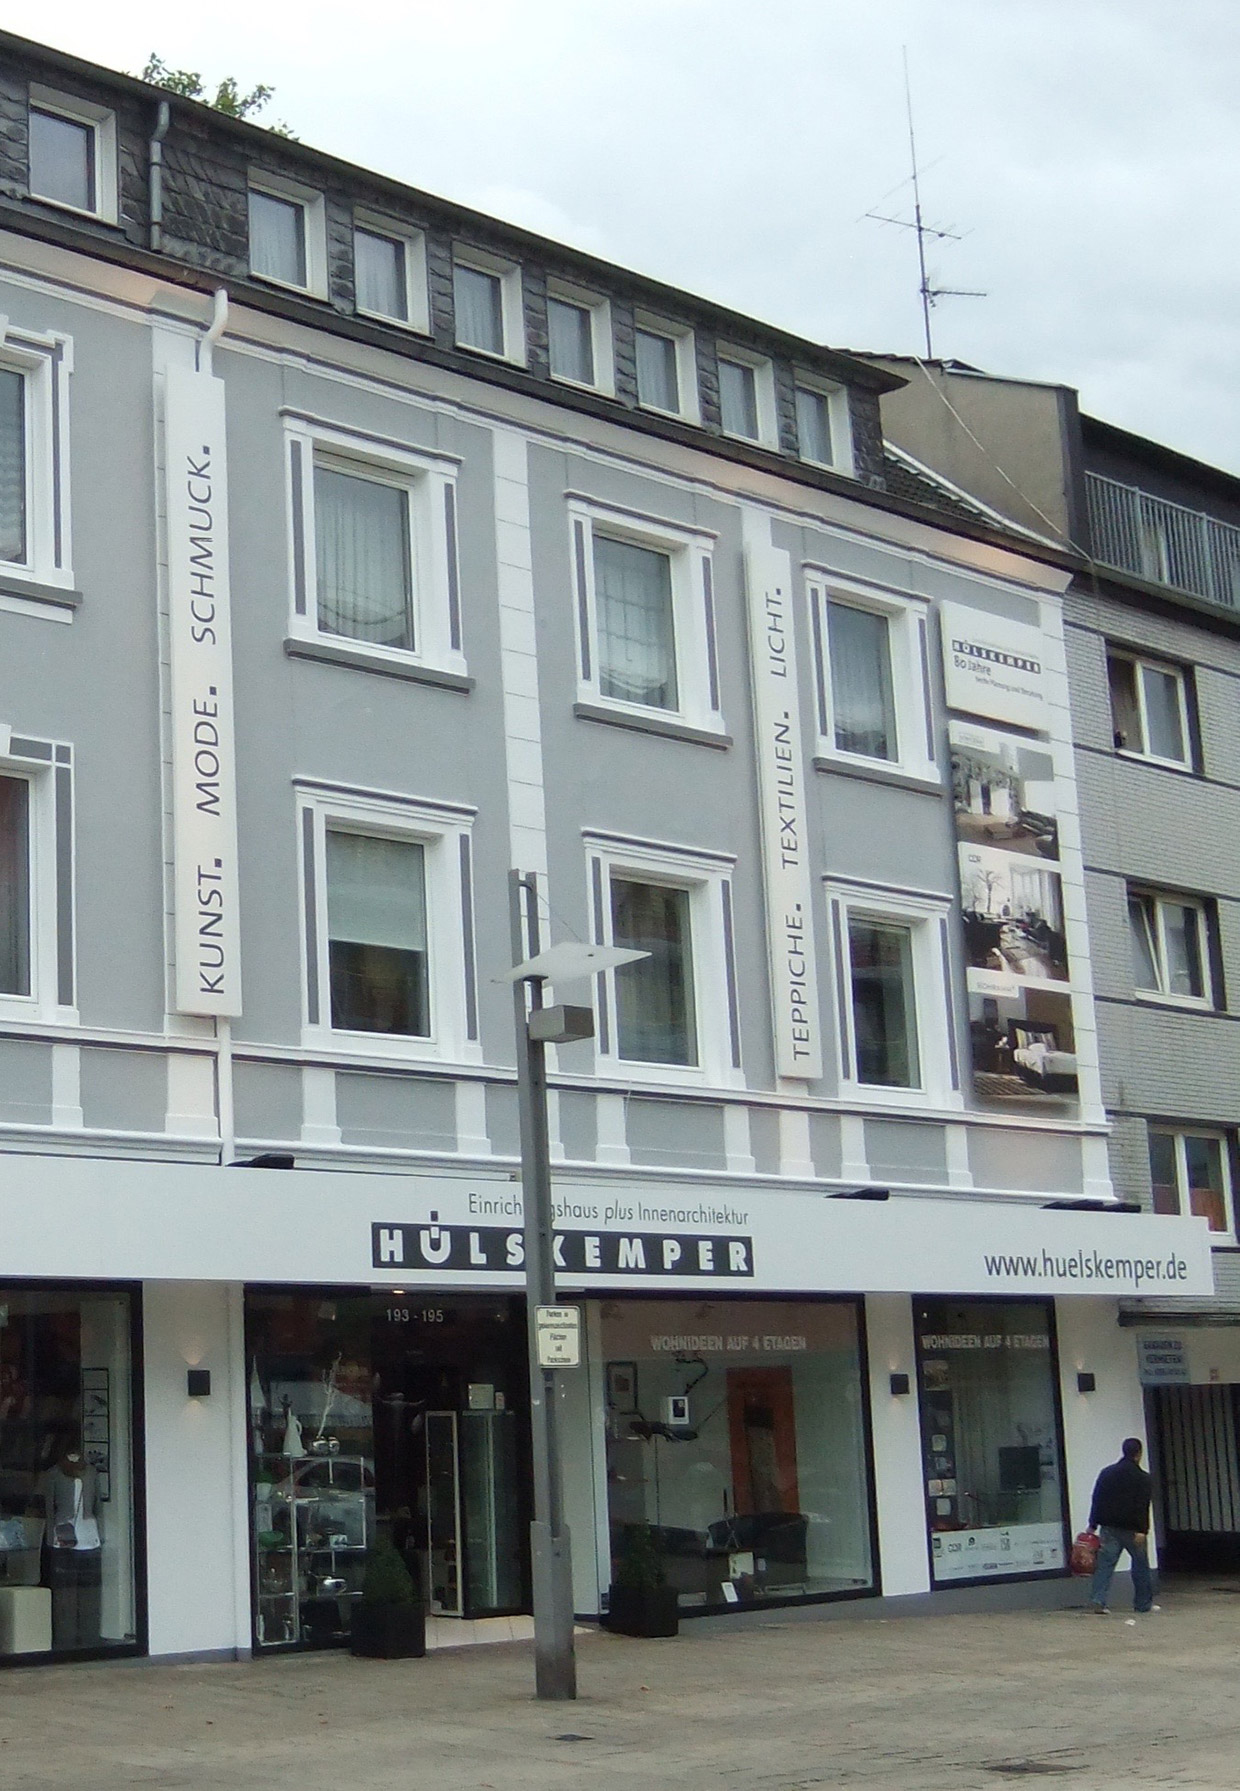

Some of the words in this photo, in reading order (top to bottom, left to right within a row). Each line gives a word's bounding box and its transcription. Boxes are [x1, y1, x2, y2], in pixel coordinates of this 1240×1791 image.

[186, 444, 216, 645] SCHMUCK.
[765, 587, 787, 678] LICHT.
[954, 655, 966, 669] 80
[193, 685, 220, 816] MODE.
[770, 711, 799, 870] TEXTILIEN.
[198, 857, 224, 995] KUNST.
[783, 903, 810, 1062] TEPPICHE.
[604, 1199, 634, 1225] plus
[638, 1202, 749, 1225] Innenarchitektur
[984, 1247, 1188, 1288] www.huelskemper.de
[386, 1308, 410, 1322] 193
[422, 1309, 444, 1323] 195
[650, 1335, 723, 1351] WOHNIDEEN
[726, 1336, 750, 1350] AUF
